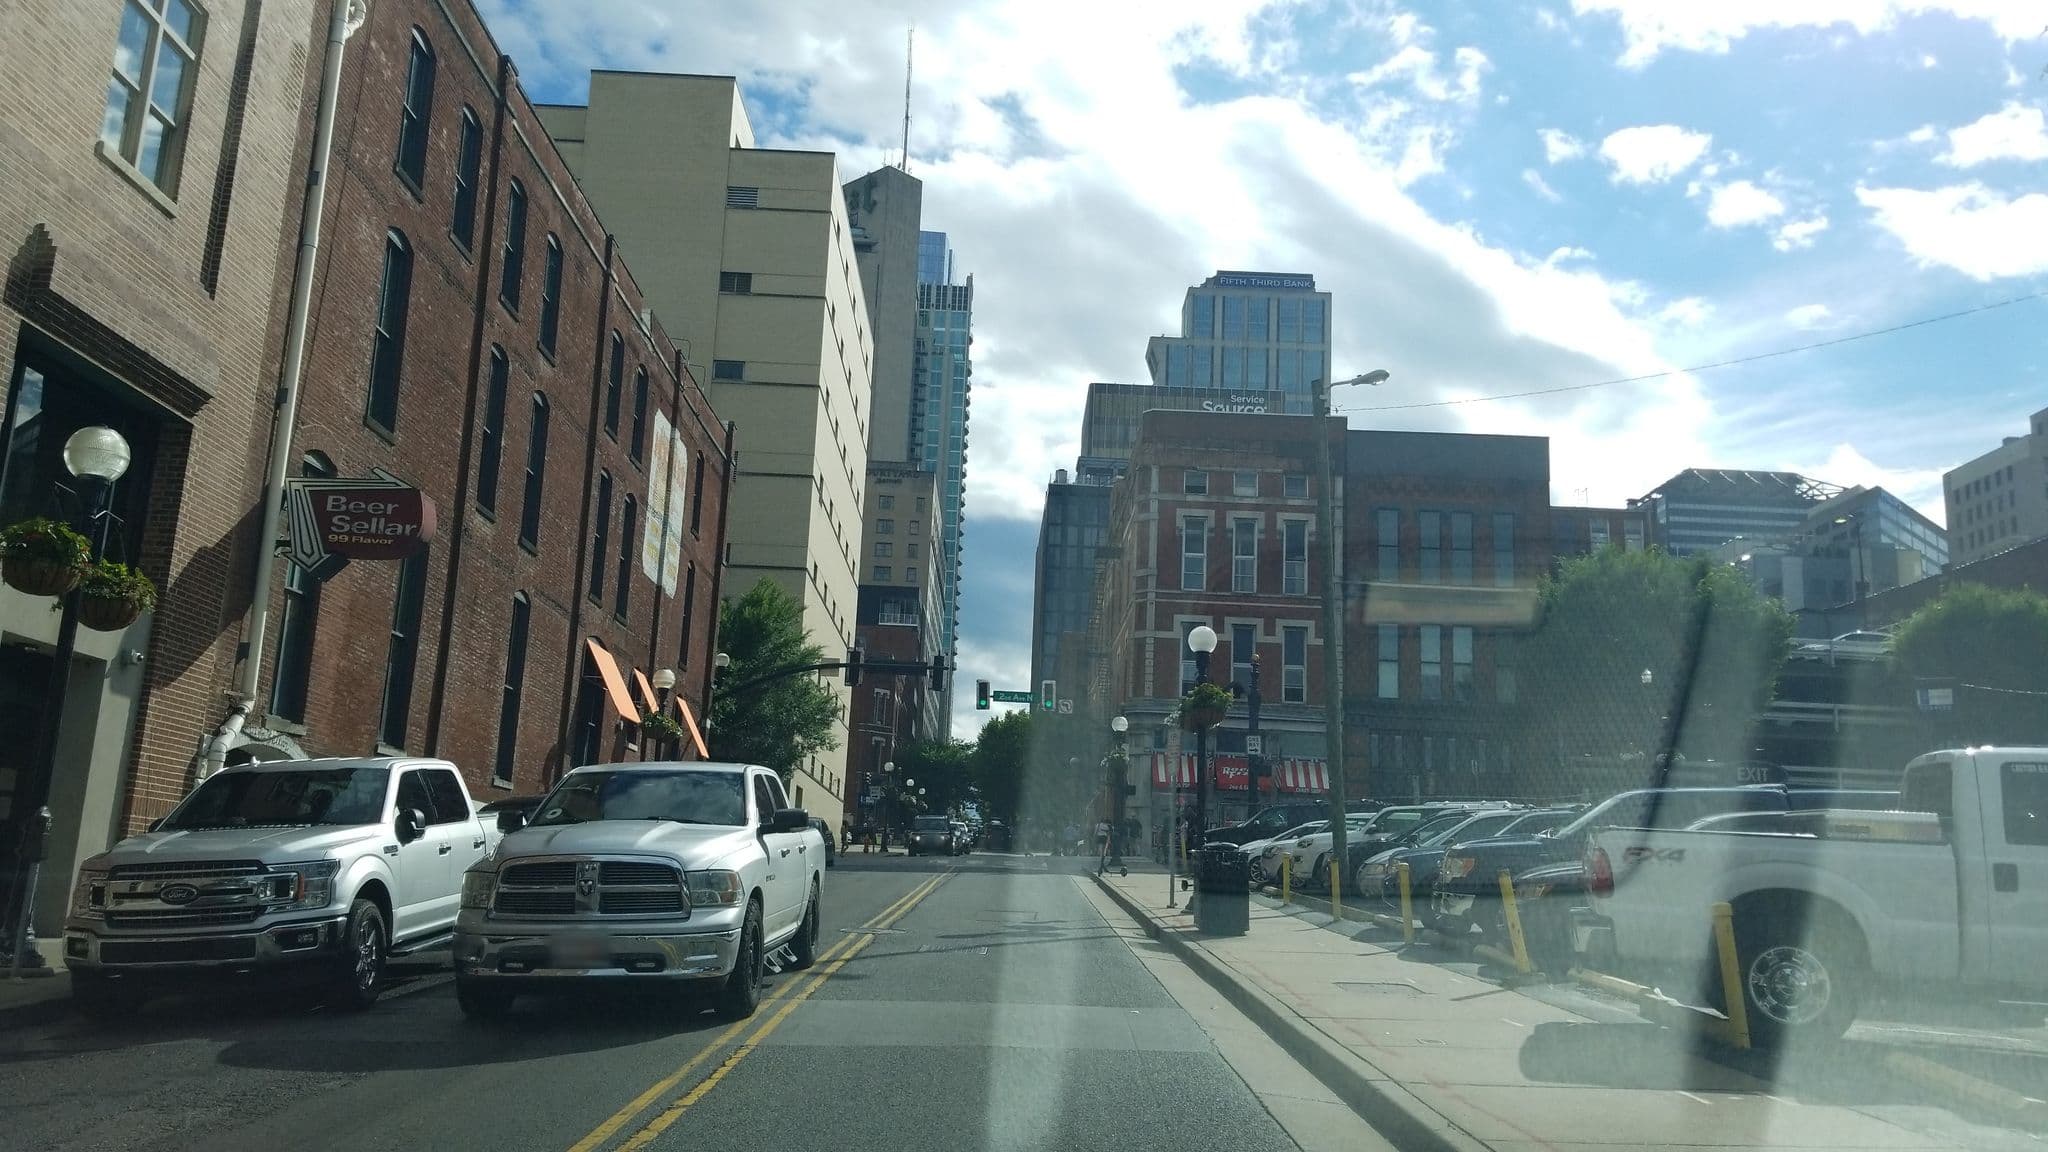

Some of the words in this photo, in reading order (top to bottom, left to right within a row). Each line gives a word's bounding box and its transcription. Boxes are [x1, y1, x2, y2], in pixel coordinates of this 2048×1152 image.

[1220, 277, 1248, 286] FIFTH
[1250, 278, 1281, 287] THIRD
[1283, 279, 1312, 288] BANK
[1230, 394, 1265, 403] Service
[1202, 401, 1265, 413] Source
[327, 495, 400, 514] Beer
[331, 515, 417, 536] Sellar
[328, 535, 348, 543] 99
[1736, 767, 1768, 783] EXIT
[168, 890, 189, 898] Ford
